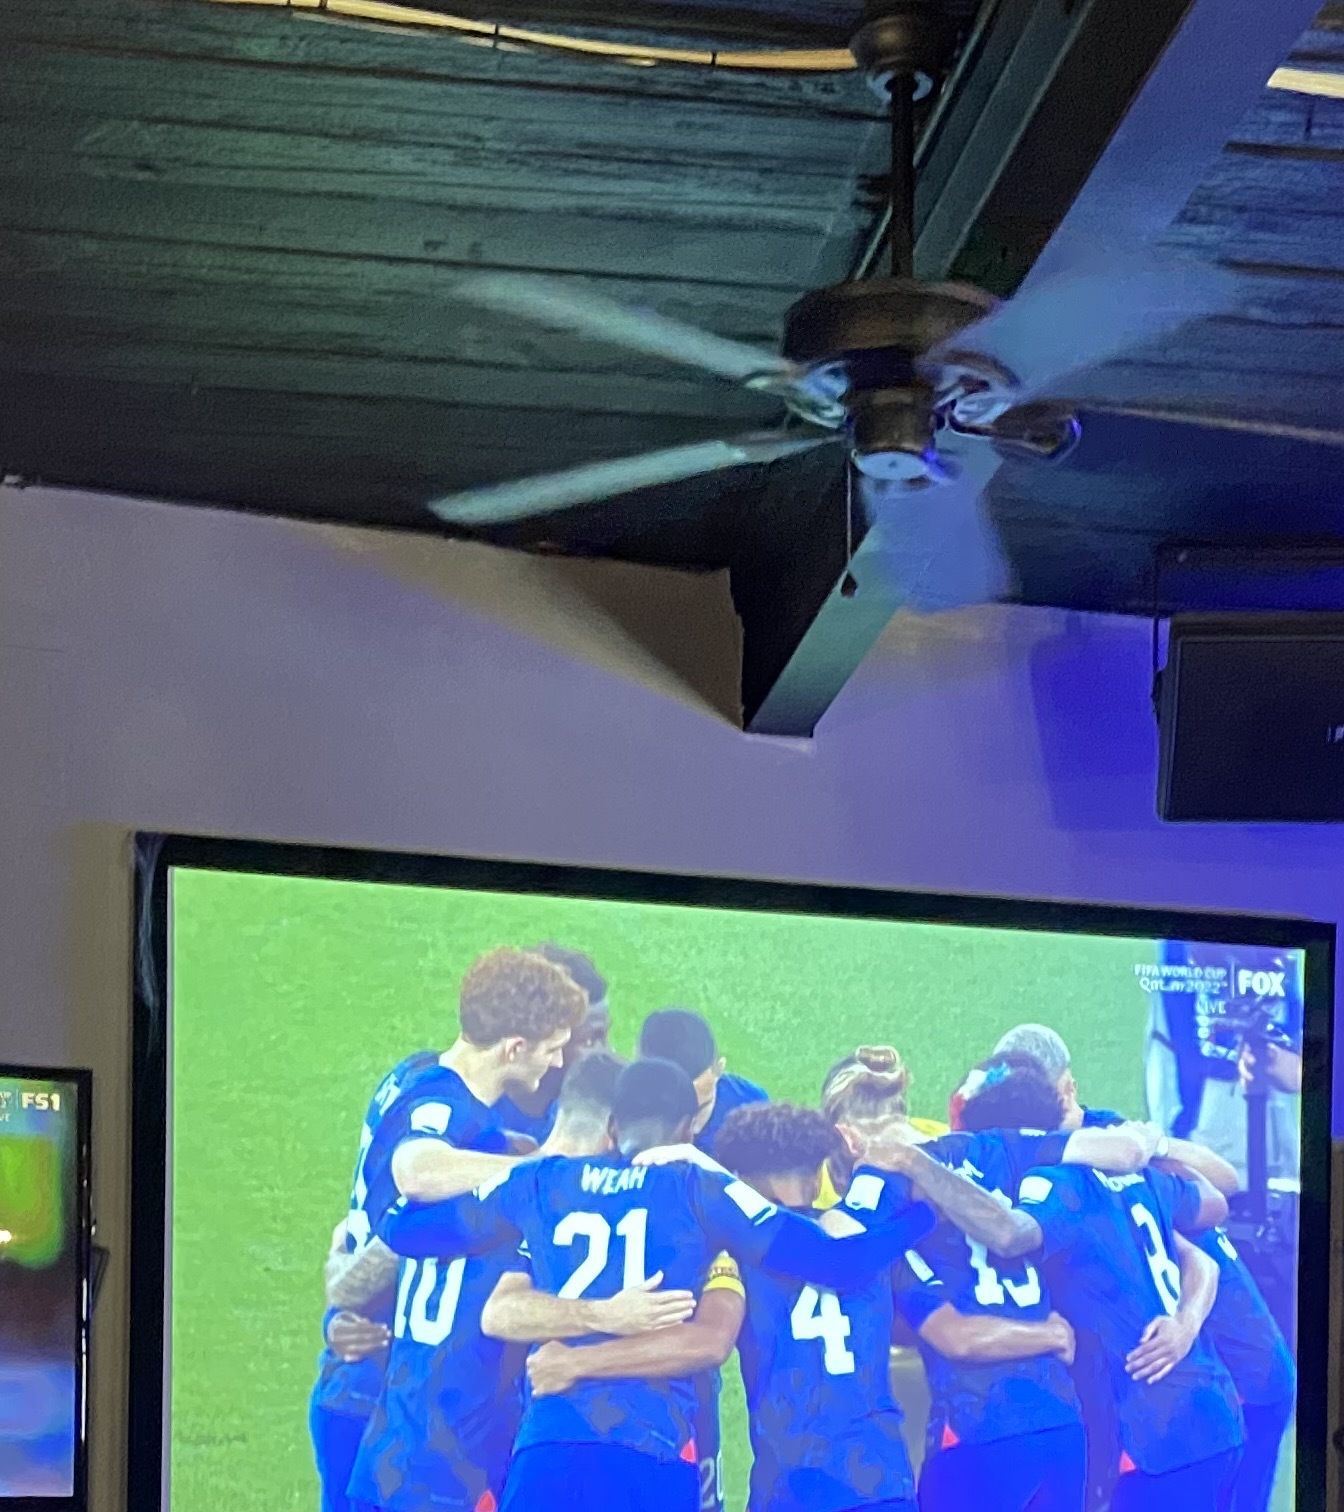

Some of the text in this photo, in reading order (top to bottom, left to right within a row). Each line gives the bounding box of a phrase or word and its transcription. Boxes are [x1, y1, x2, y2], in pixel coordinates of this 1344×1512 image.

[1134, 964, 1227, 980] FIFA WORLD CUP
[1237, 968, 1285, 998] FOX
[22, 1092, 61, 1112] FS1
[581, 1164, 648, 1194] WEAH
[552, 1208, 649, 1301] 21
[394, 1256, 467, 1346] 10
[790, 1283, 856, 1376] 4
